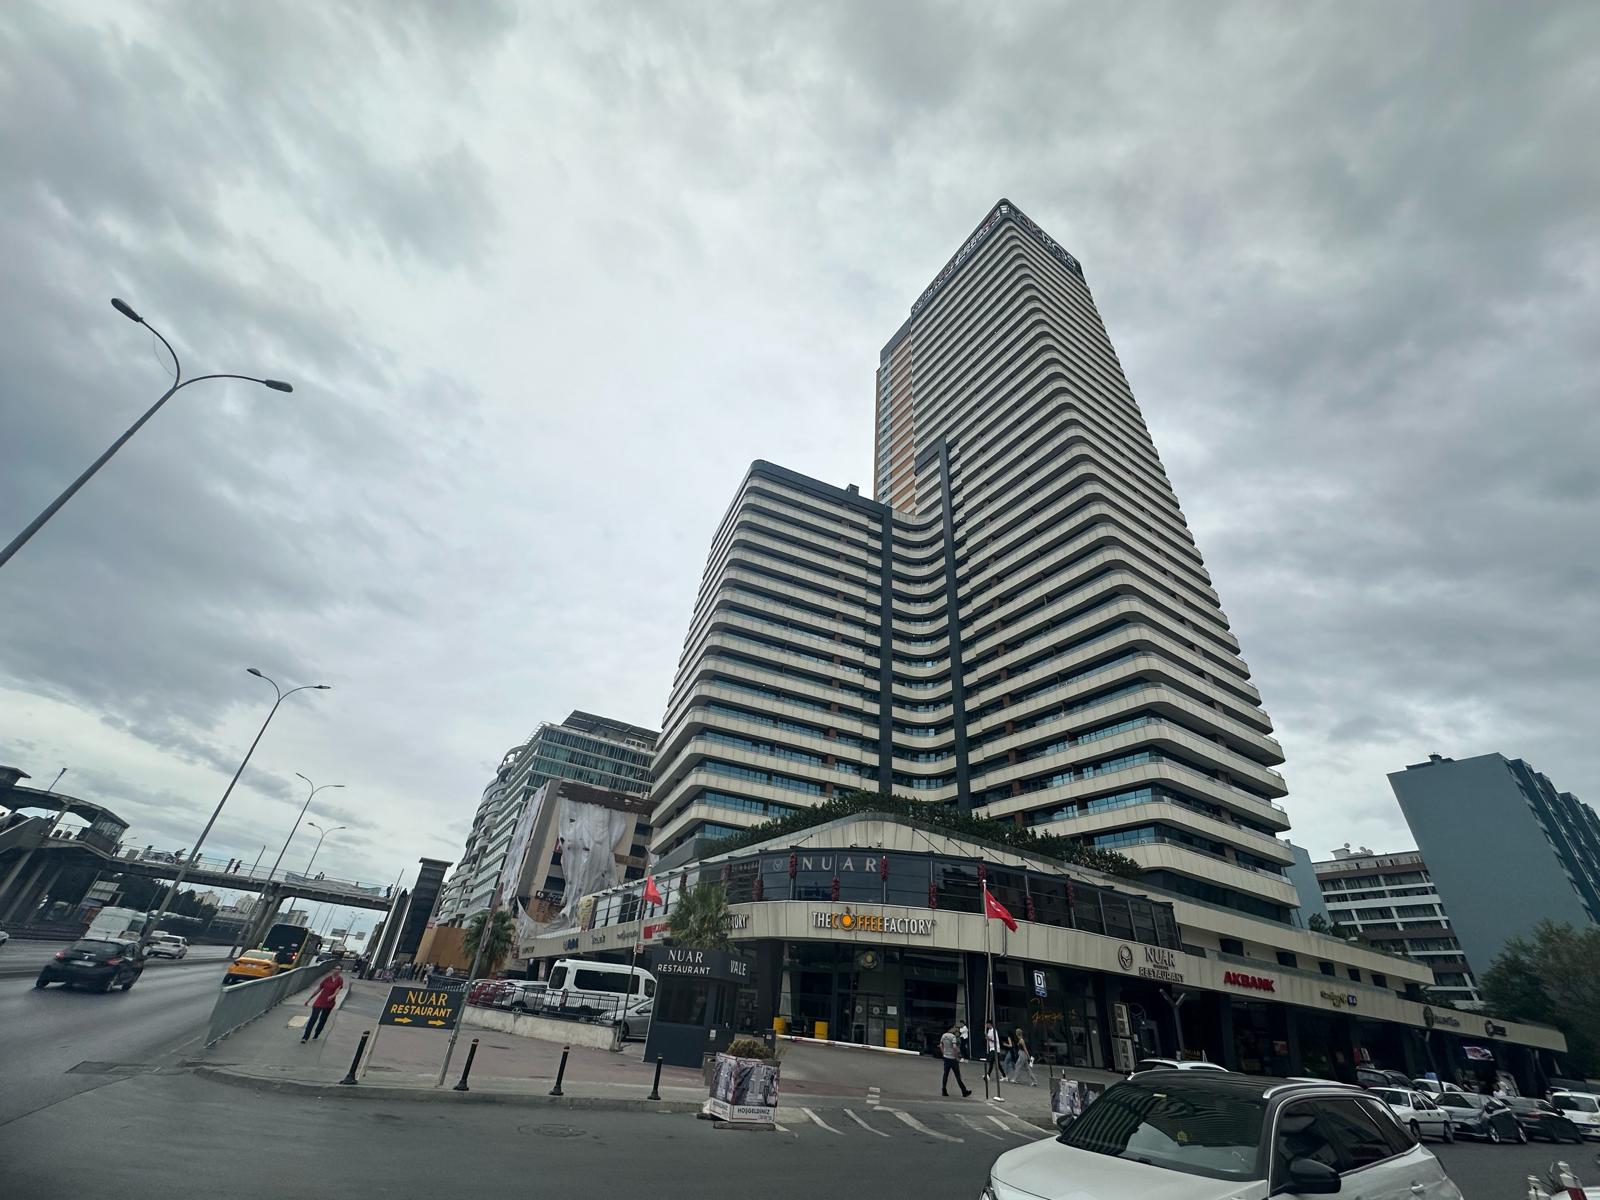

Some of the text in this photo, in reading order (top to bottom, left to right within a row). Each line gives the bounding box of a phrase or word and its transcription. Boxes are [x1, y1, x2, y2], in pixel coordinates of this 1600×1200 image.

[802, 856, 876, 872] NUAR
[668, 949, 703, 963] NUAR
[1144, 946, 1175, 967] NUAR
[657, 964, 711, 975] RESTAURANT
[730, 960, 747, 976] VALE
[1138, 966, 1184, 983] RESTAURANT
[1223, 971, 1275, 992] AKBANK
[405, 990, 448, 1006] NUAR
[390, 1004, 453, 1017] RESTAURANT
